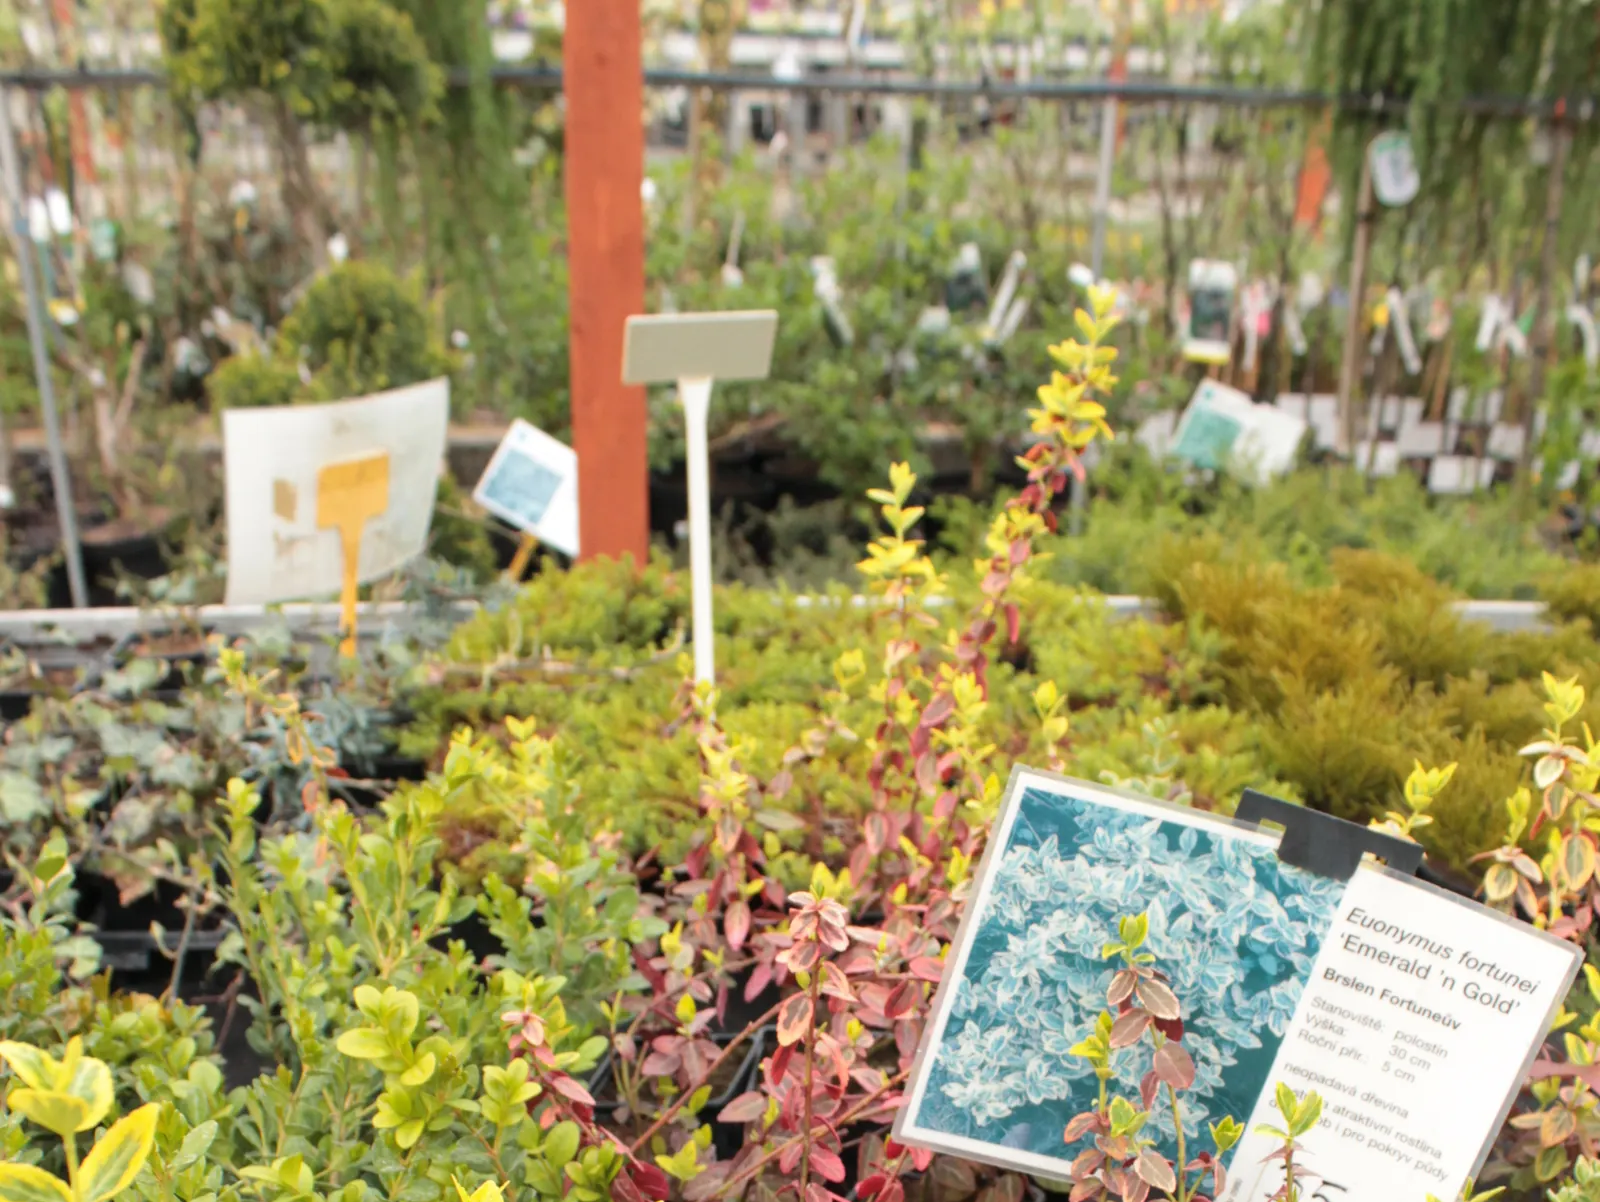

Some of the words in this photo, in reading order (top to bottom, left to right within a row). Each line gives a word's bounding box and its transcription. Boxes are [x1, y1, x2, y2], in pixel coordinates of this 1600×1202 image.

[1346, 907, 1454, 960] Euonymus
[1458, 951, 1541, 995] fortunei
[1323, 967, 1375, 996] Brslen
[1379, 988, 1461, 1030] Fortuneův
[1381, 1061, 1391, 1073] 5
[1394, 1068, 1416, 1083] cm
[1389, 1045, 1407, 1060] 30
[1409, 1055, 1431, 1071] cm
[1284, 1062, 1357, 1097] neopadavá
[1360, 1089, 1409, 1119] dřevina
[1341, 1126, 1365, 1143] pro
[1367, 1136, 1413, 1163] pokryv
[1394, 1130, 1443, 1160] rostlina
